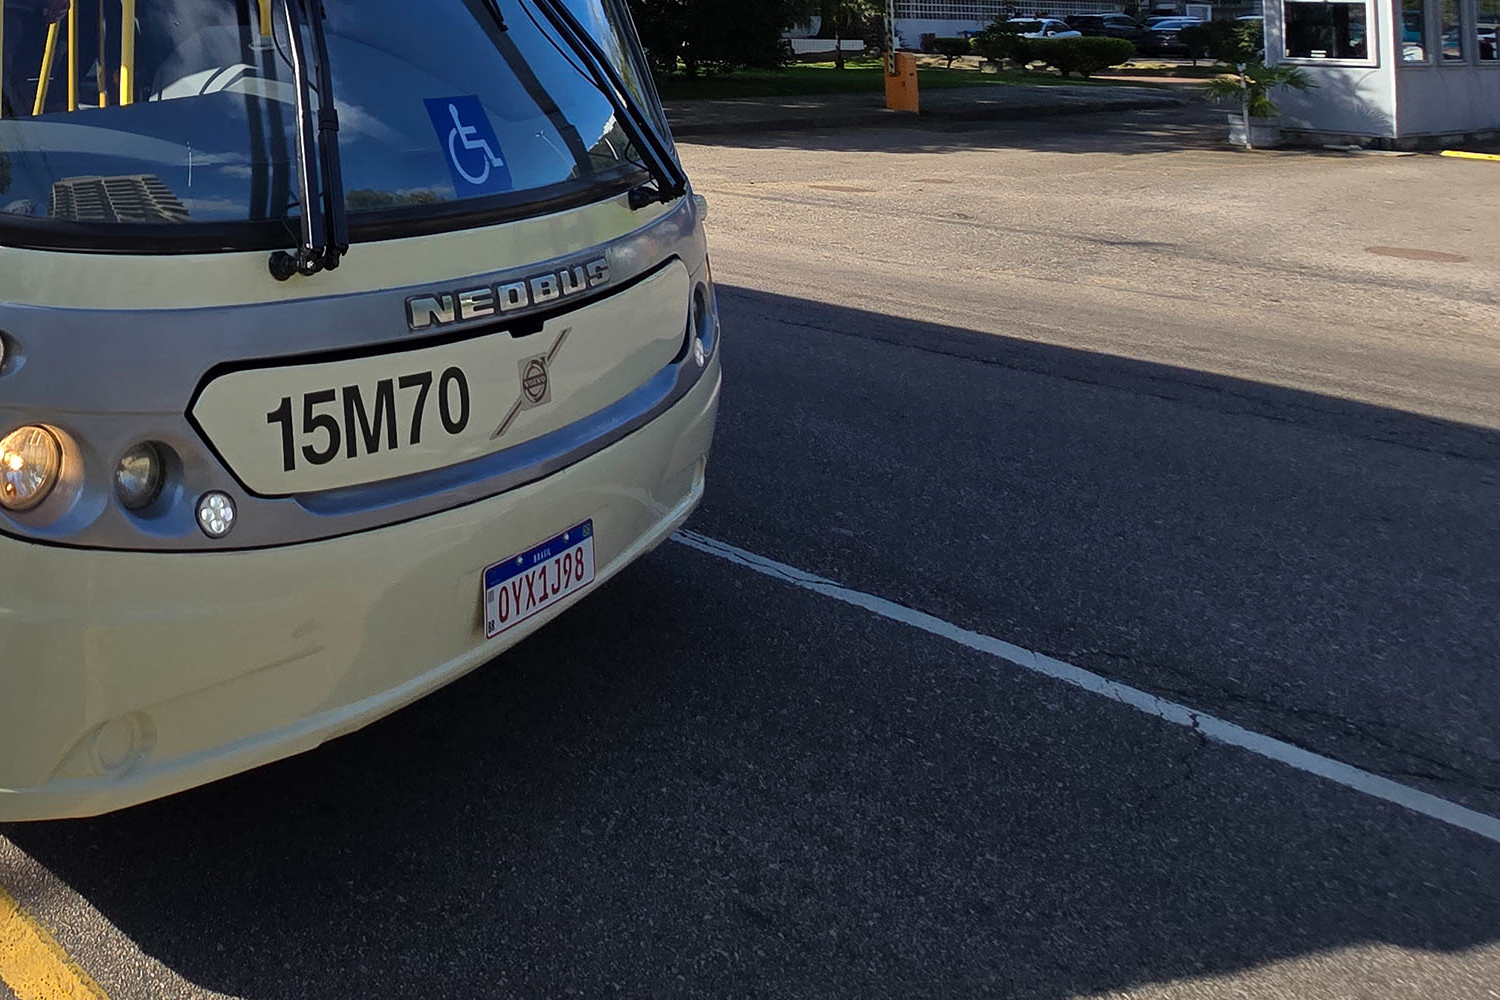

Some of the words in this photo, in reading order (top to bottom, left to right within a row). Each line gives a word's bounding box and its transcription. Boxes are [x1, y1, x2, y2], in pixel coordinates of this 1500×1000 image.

[408, 257, 612, 329] NEOBUS
[266, 366, 471, 472] 15M70
[498, 546, 585, 623] OYX1J98
